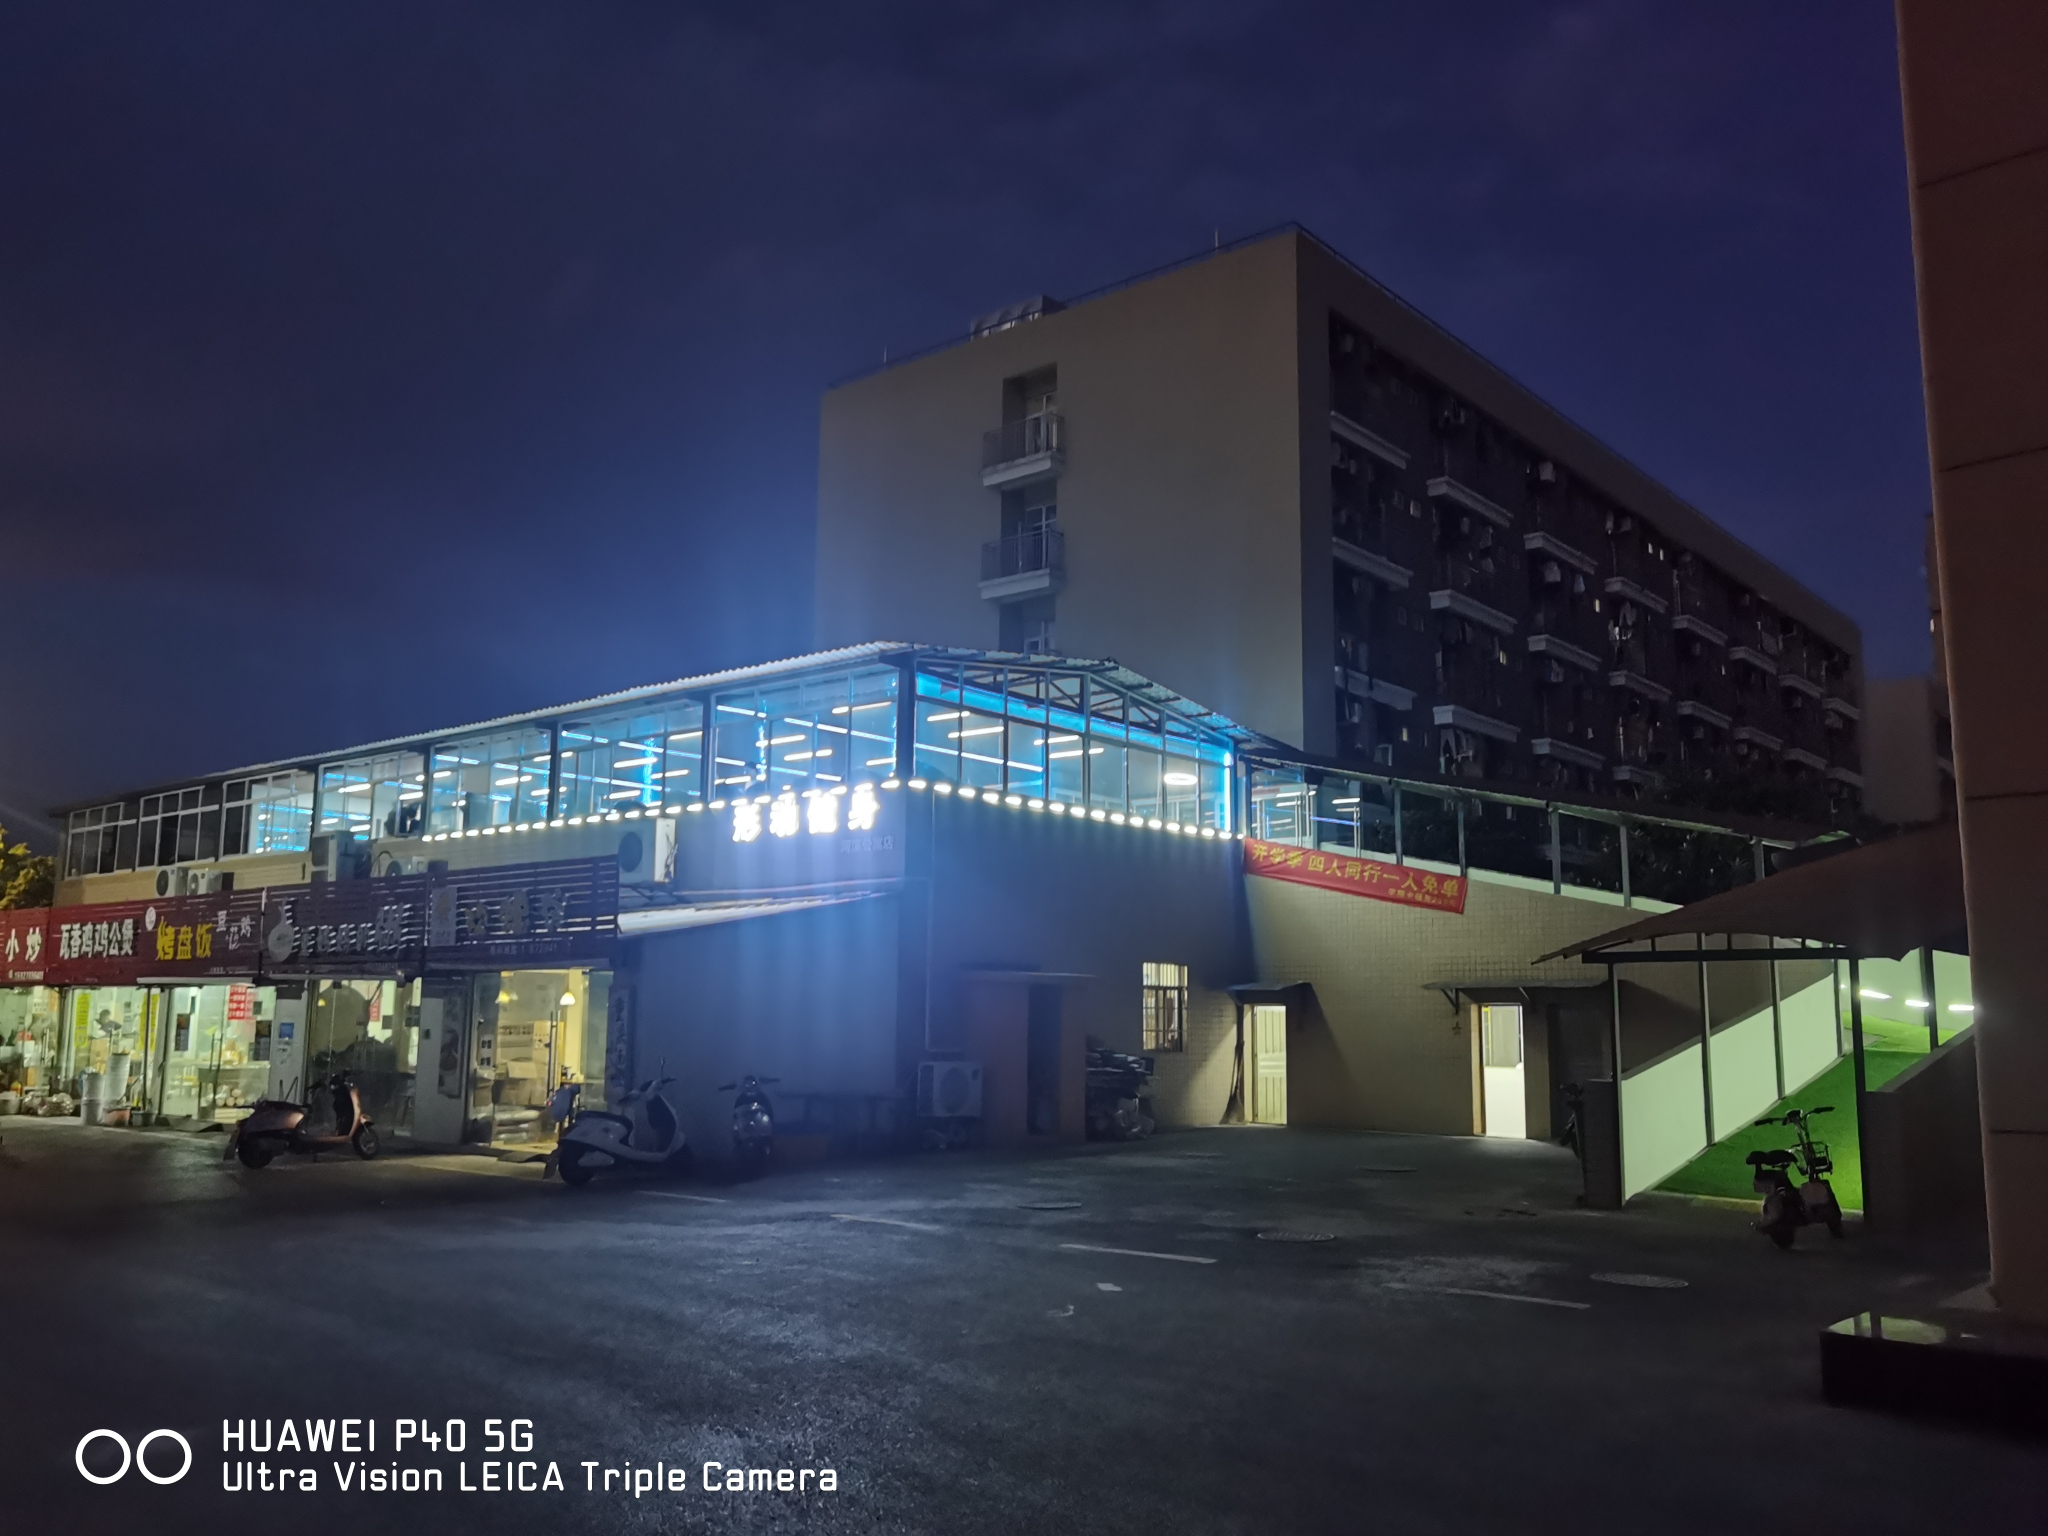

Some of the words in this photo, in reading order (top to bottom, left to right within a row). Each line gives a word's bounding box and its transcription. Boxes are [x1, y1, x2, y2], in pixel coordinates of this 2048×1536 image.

[1307, 854, 1460, 898] 四人同行一人免单
[5, 926, 43, 963] 小炒
[155, 915, 213, 961] 烤盘饭
